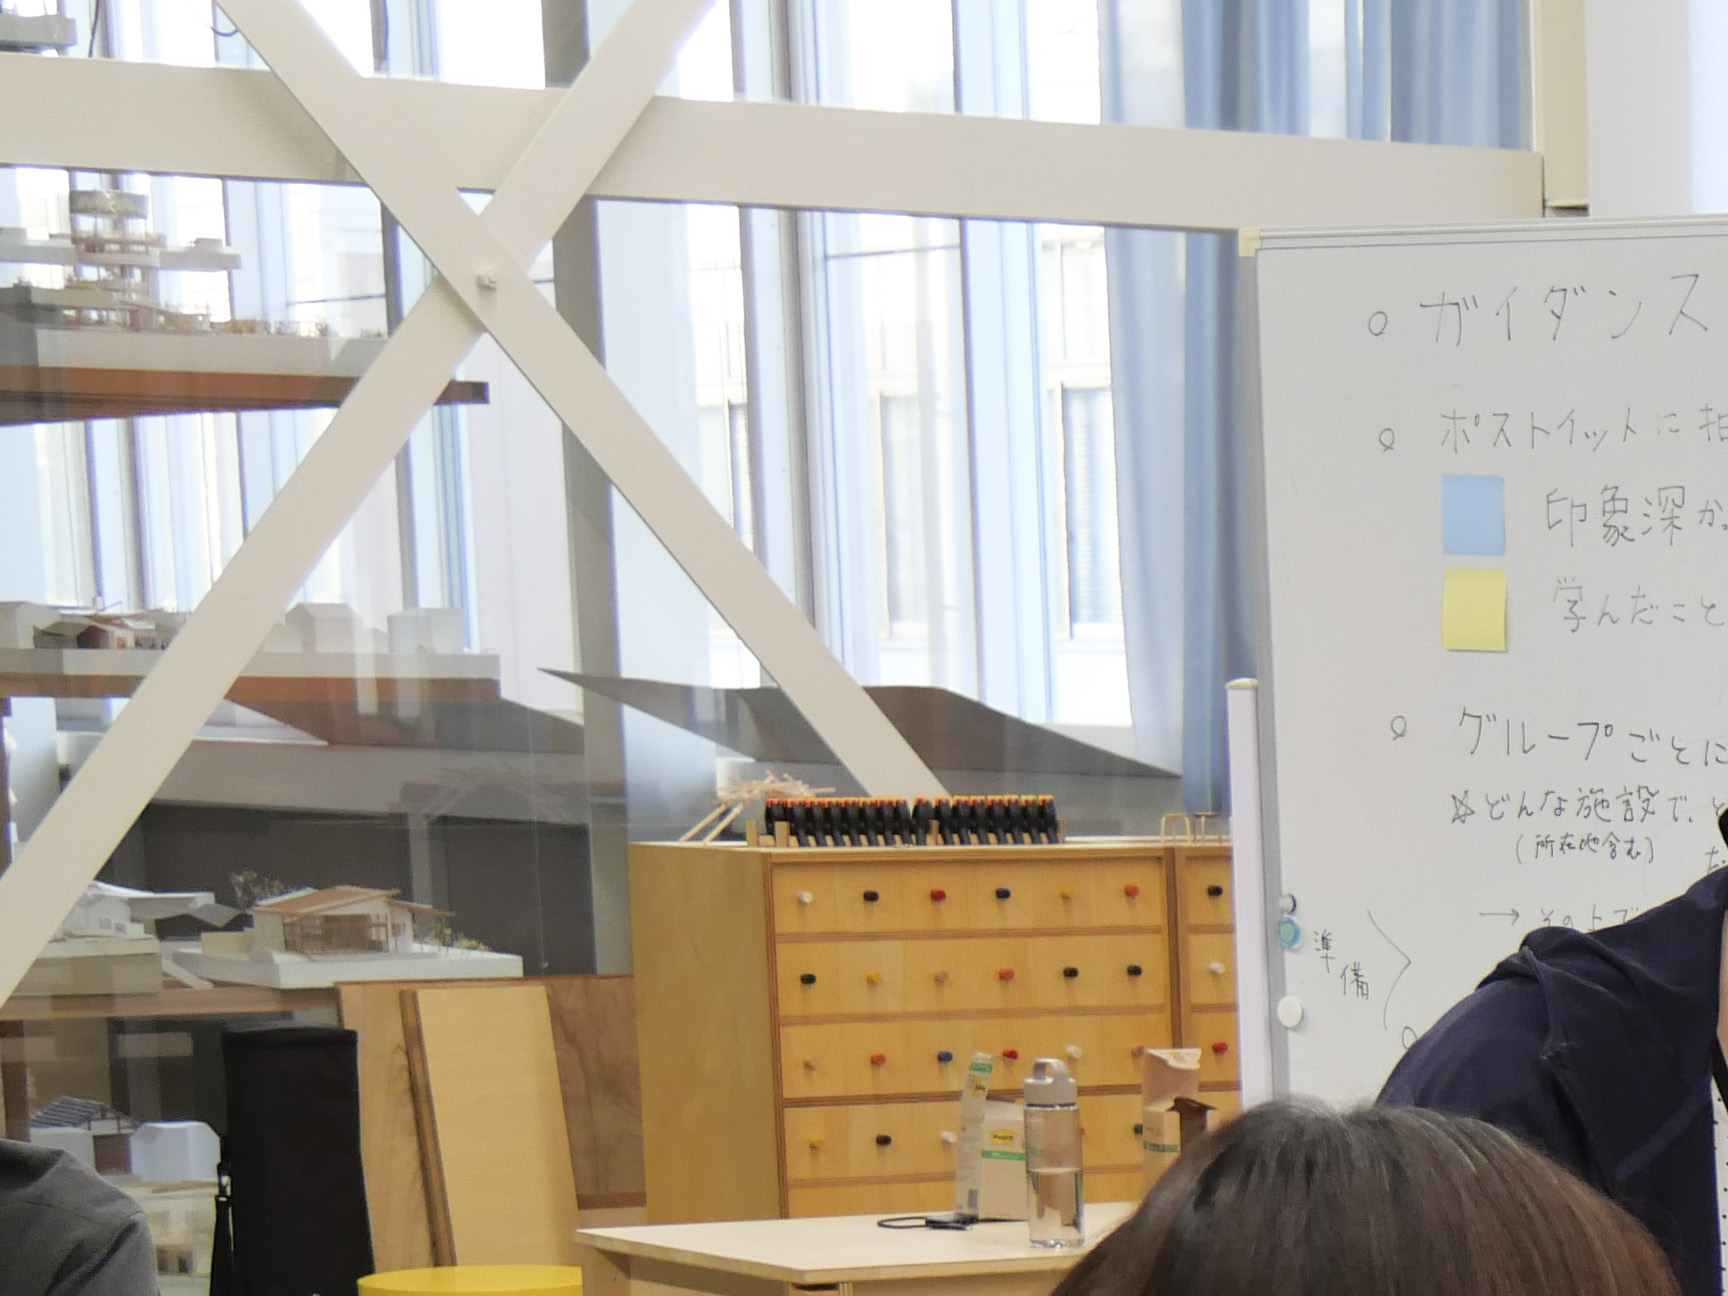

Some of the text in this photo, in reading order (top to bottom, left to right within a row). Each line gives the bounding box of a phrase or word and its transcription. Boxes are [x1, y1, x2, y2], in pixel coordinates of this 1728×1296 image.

[1419, 273, 1709, 347] ガイダンス
[1554, 577, 1726, 633] 学んだこと
